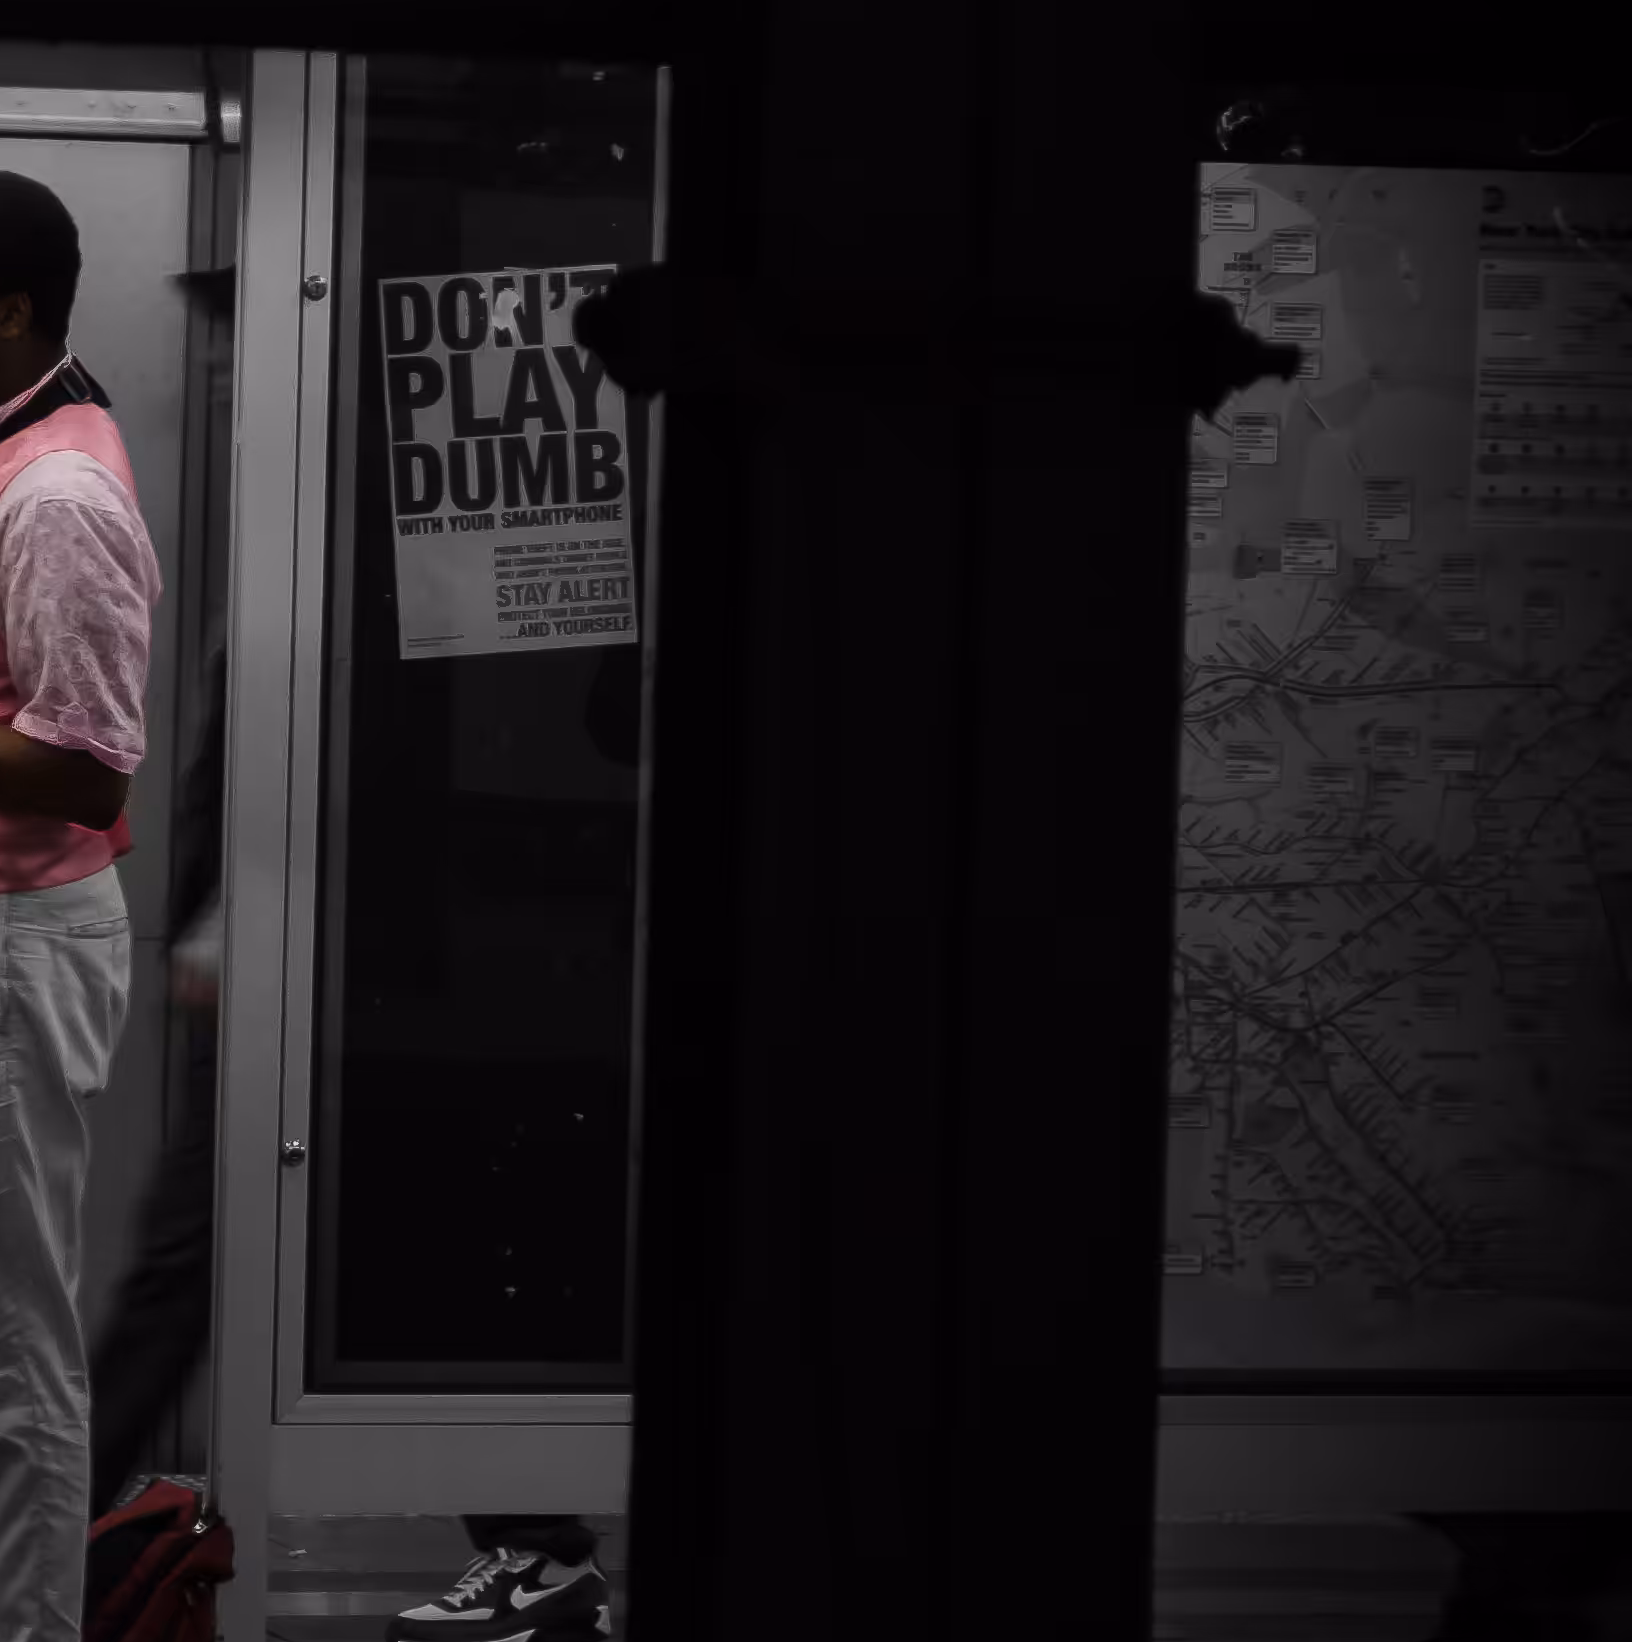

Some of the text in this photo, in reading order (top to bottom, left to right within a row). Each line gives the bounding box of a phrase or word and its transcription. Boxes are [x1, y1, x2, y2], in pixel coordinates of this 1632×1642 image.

[388, 345, 606, 442] PLAY
[393, 430, 625, 515] DUMB
[397, 503, 624, 536] WITH YOUR SMARTPHONE
[496, 576, 630, 608] STAY ALERT
